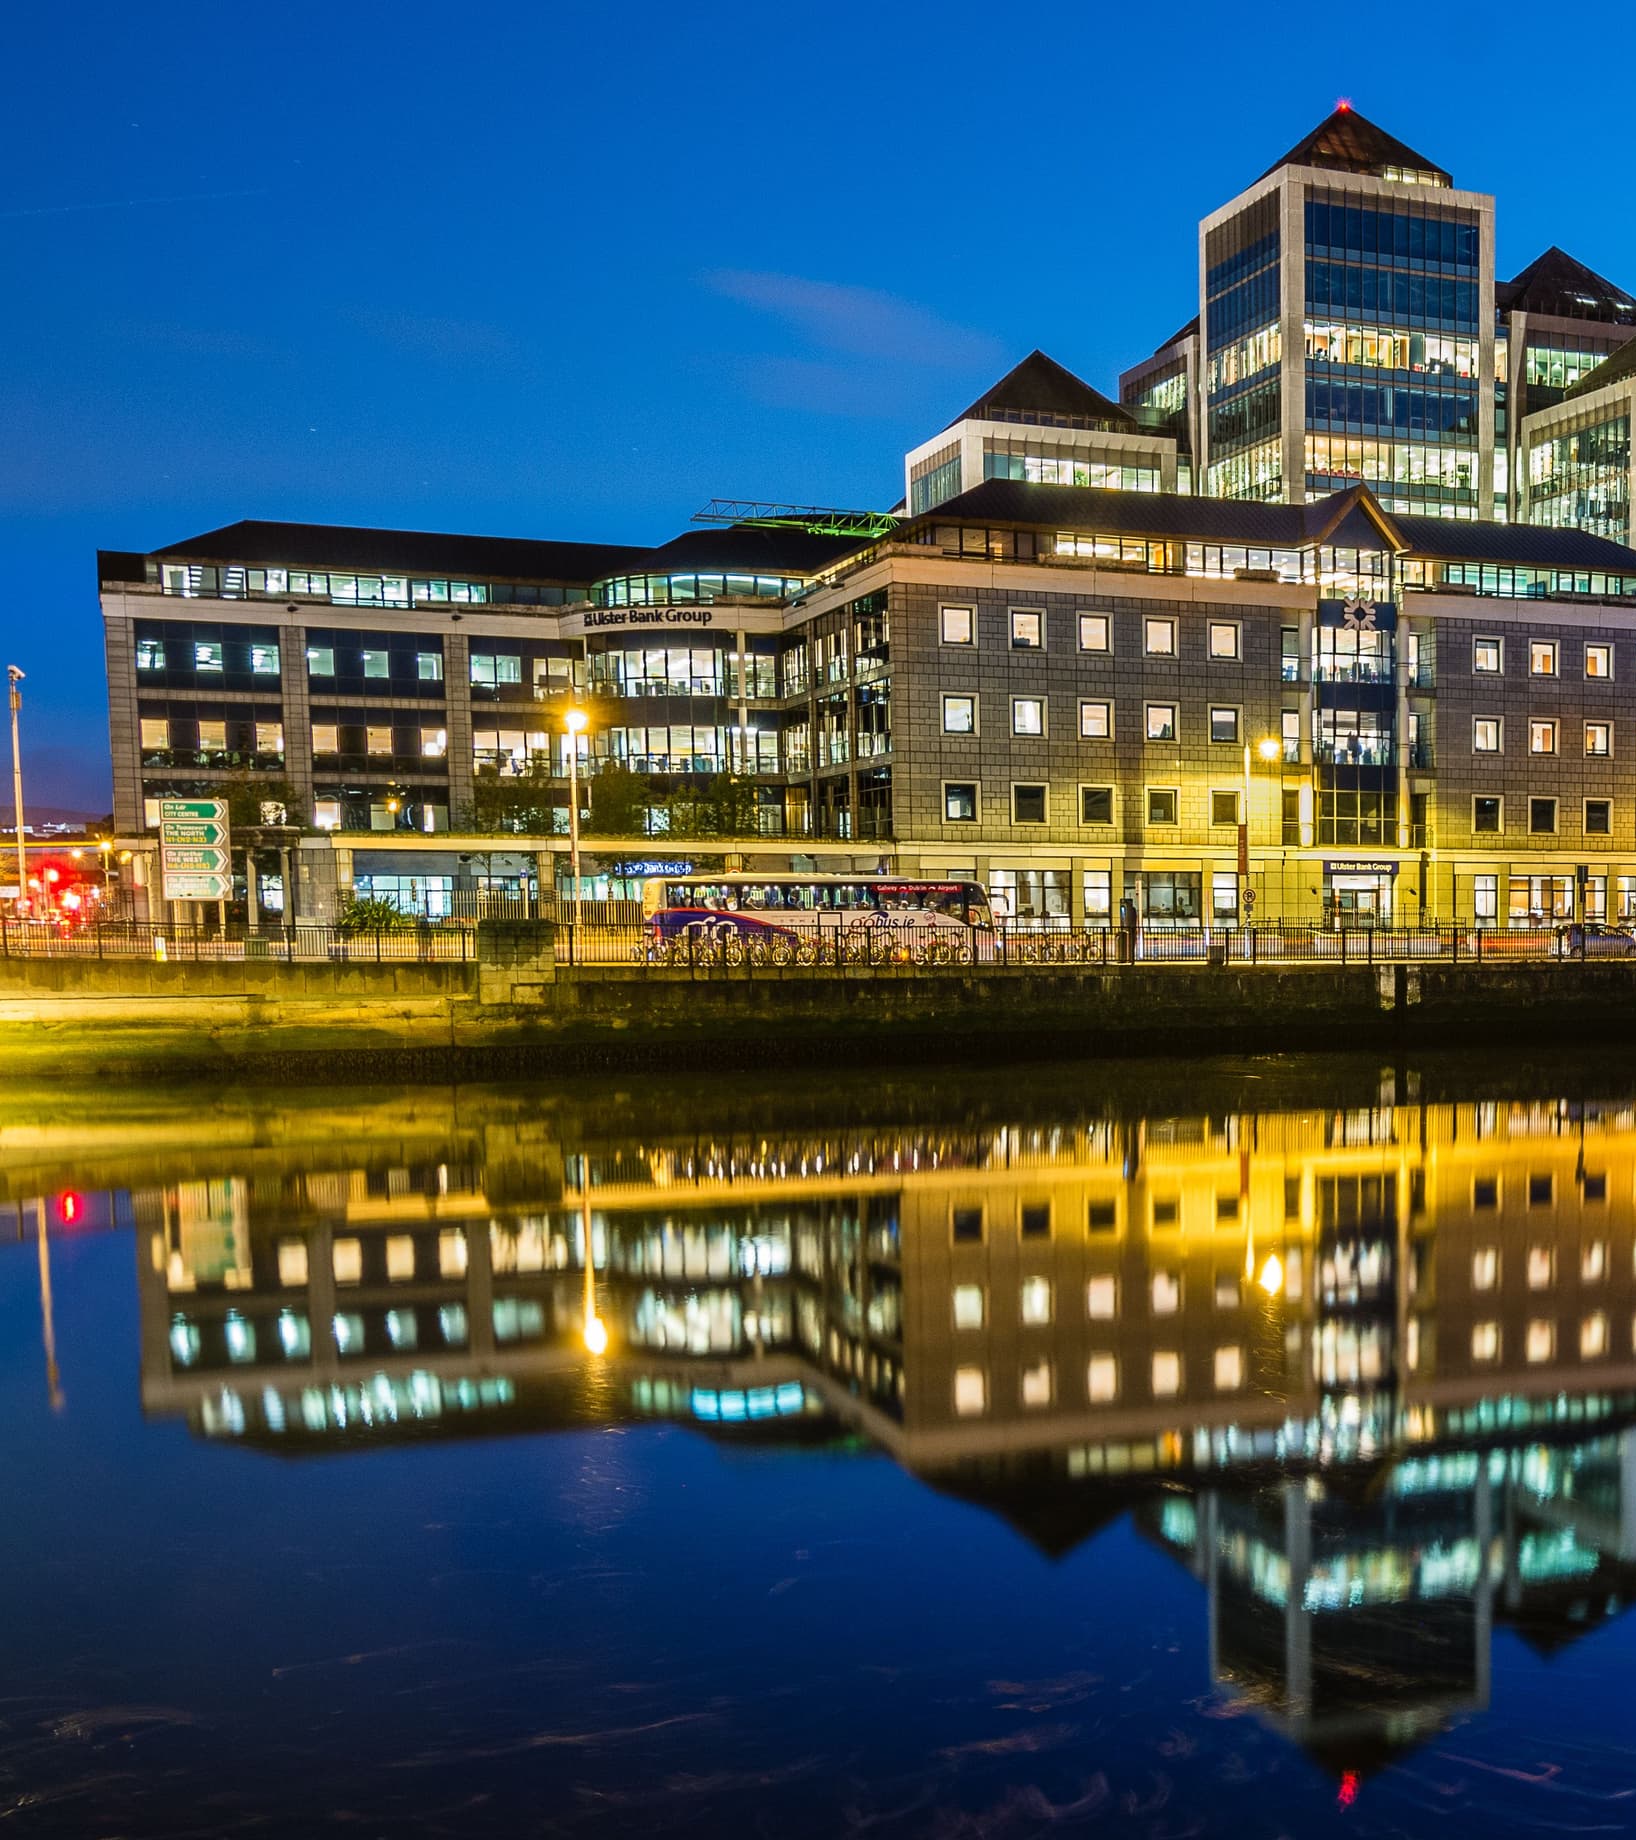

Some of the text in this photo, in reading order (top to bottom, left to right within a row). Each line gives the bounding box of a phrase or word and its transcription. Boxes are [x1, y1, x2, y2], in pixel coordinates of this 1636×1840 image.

[593, 609, 712, 626] Ulster Bank Group
[1337, 862, 1392, 872] Ulster Bank Group
